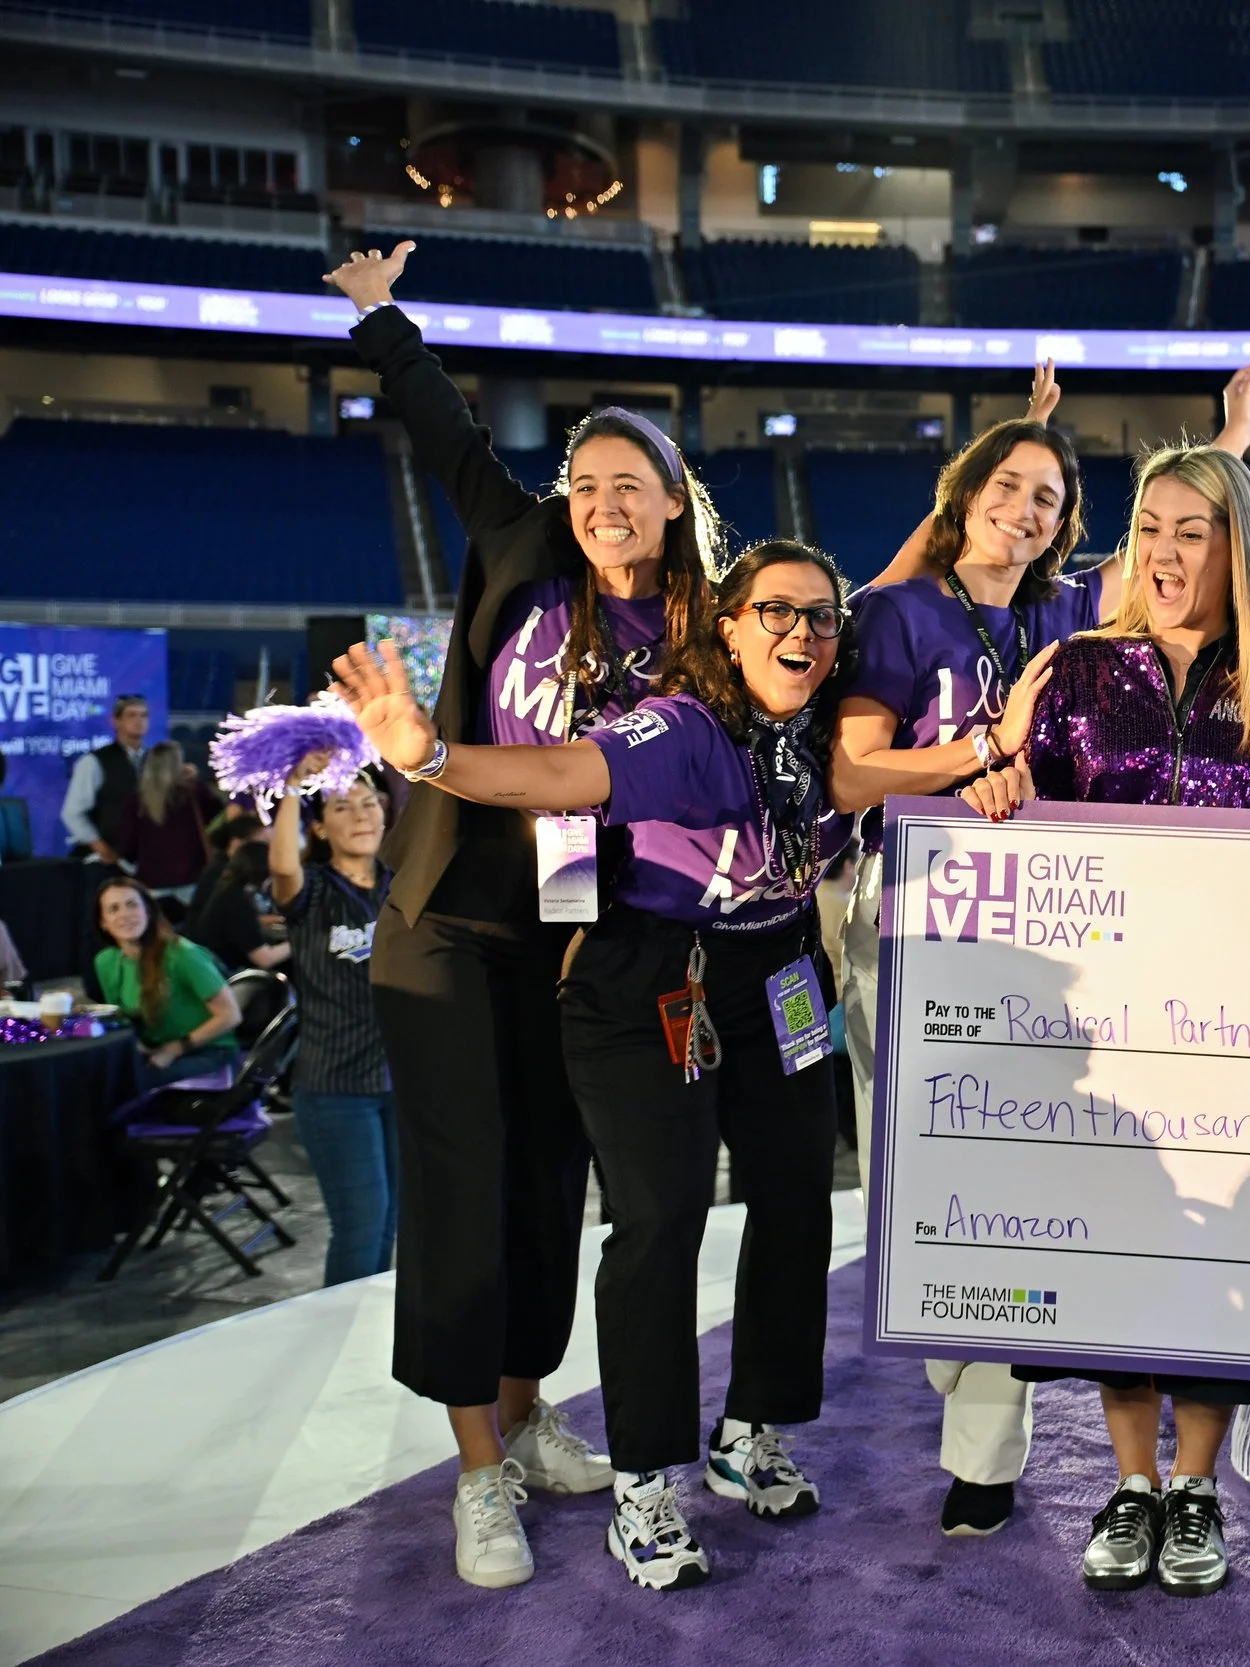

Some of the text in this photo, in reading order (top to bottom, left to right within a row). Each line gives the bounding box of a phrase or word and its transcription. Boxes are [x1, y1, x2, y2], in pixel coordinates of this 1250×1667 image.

[53, 653, 98, 676] GIVE
[989, 647, 1005, 674] Miami
[53, 676, 109, 698] MIAMI
[51, 699, 88, 721] DAY
[1027, 854, 1104, 883] GIVE
[1026, 887, 1126, 917] MIAMI
[1025, 920, 1091, 948] DAY
[781, 971, 800, 989] SCAN
[955, 1006, 970, 1019] TO
[974, 1006, 996, 1020] THE
[1001, 995, 1129, 1045] Radical
[924, 1022, 981, 1037] ORDER OF
[925, 1073, 1075, 1136] Fifteen
[945, 1194, 1089, 1240] Amazon
[923, 1284, 1011, 1302] THE MIAMI
[921, 1302, 1057, 1325] FOUNDATION
